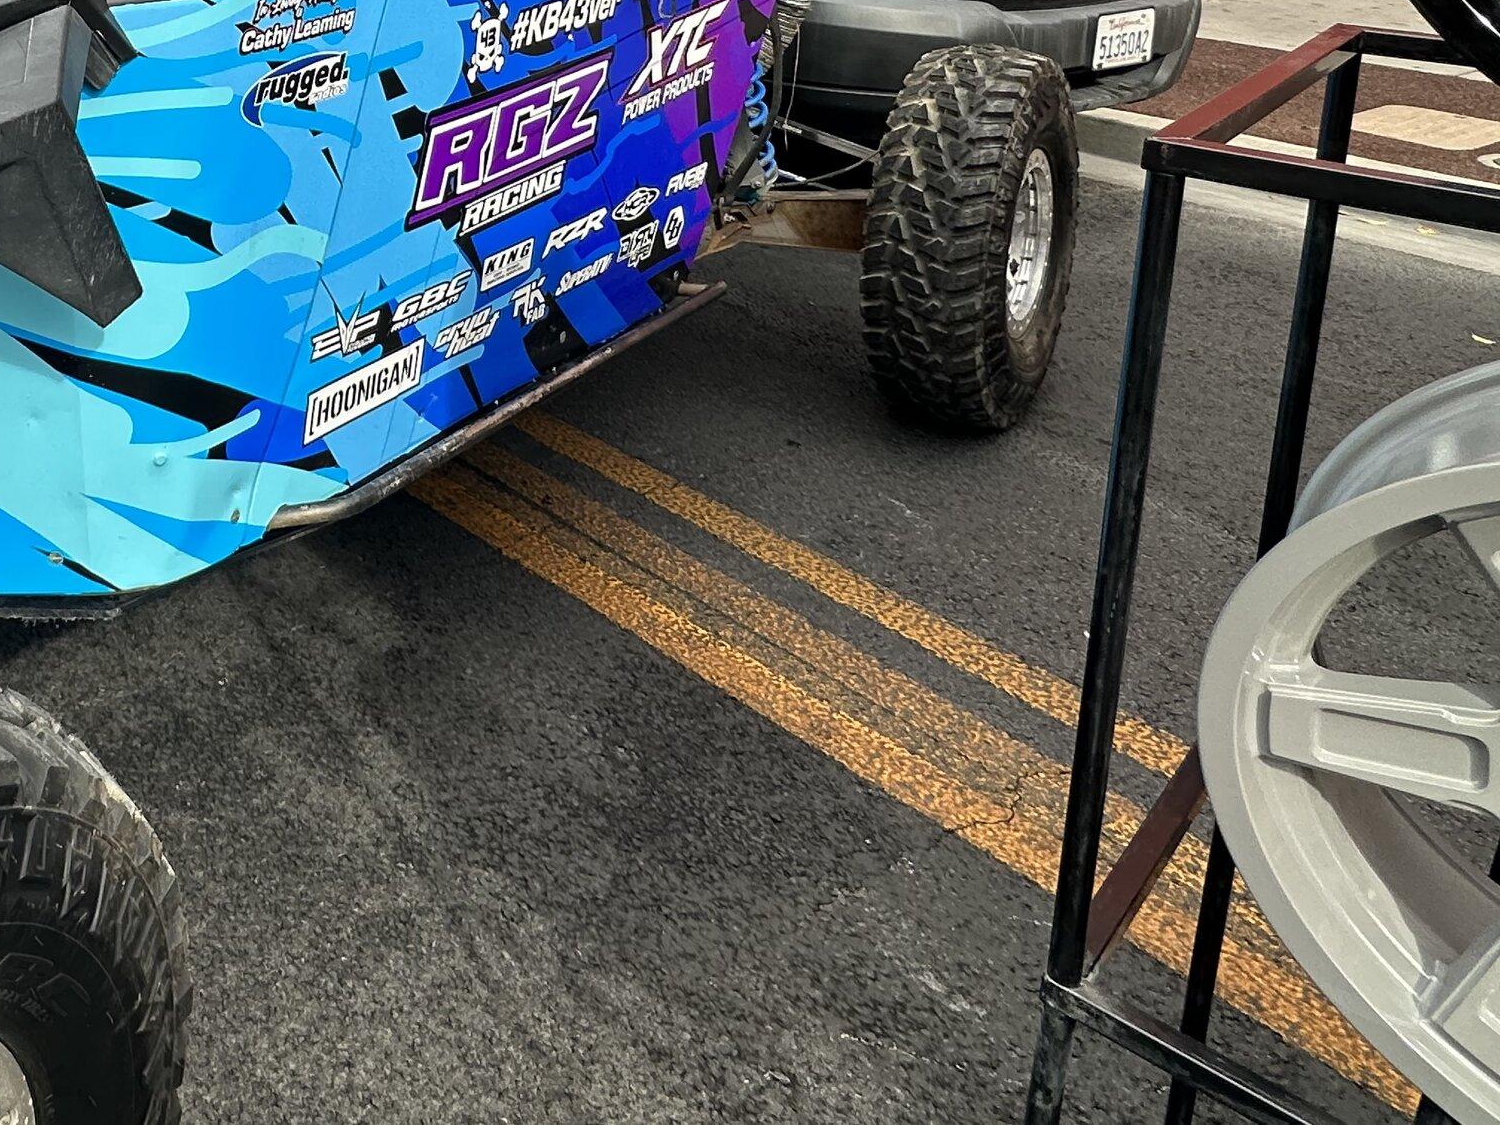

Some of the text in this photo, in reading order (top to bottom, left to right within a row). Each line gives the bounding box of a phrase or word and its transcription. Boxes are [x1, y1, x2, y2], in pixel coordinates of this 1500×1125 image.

[241, 26, 293, 53] Cathy
[293, 9, 356, 41] Leaming
[1098, 29, 1150, 61] 51350A2
[622, 62, 715, 125] POWER PRODUCTS
[415, 60, 609, 212] RGZ
[461, 163, 565, 233] RACING
[484, 241, 532, 276] KING
[541, 207, 608, 259] RZR
[391, 270, 473, 323] GBC
